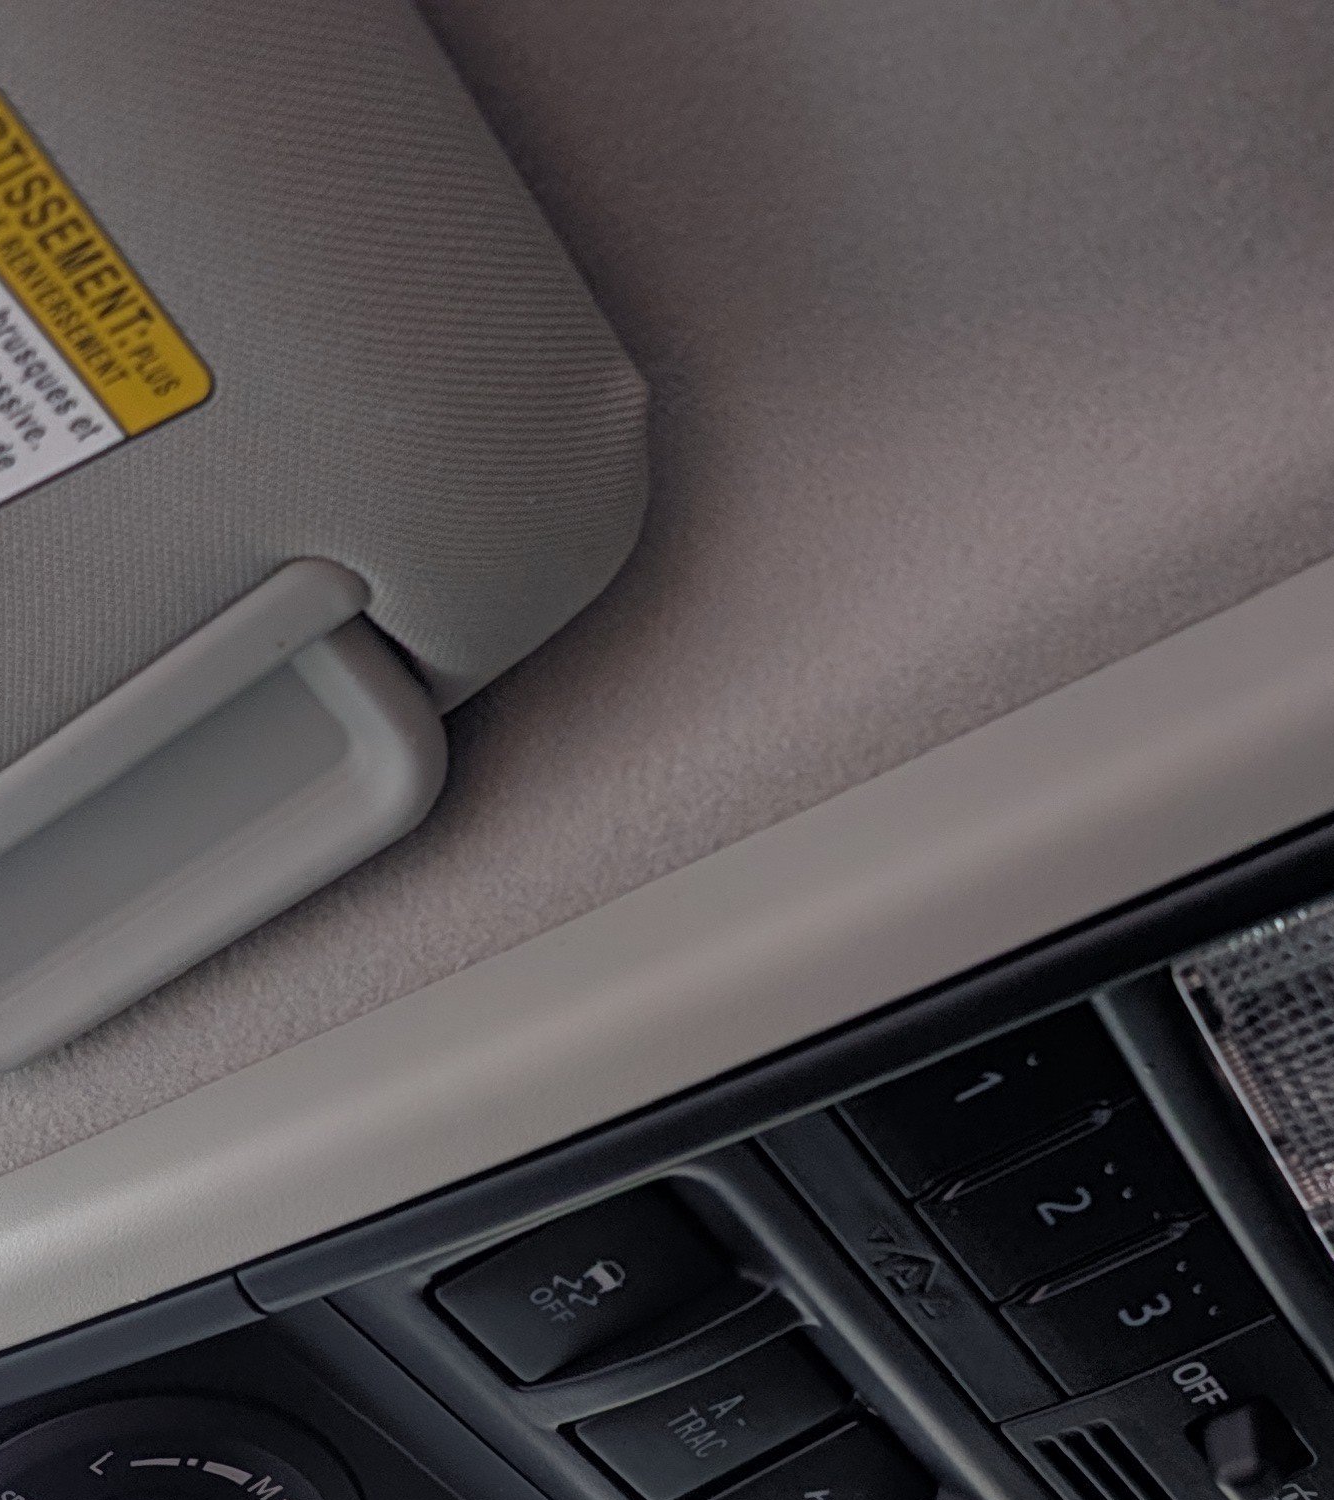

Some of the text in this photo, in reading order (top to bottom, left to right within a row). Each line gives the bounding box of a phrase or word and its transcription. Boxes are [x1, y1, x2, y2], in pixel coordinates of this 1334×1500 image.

[127, 343, 182, 397] PLUS
[69, 415, 104, 443] et
[1035, 1186, 1093, 1227] 2
[529, 1287, 577, 1323] OFF
[1117, 1292, 1173, 1327] 3
[1171, 1361, 1229, 1408] OFF
[667, 1407, 728, 1459] TRAC
